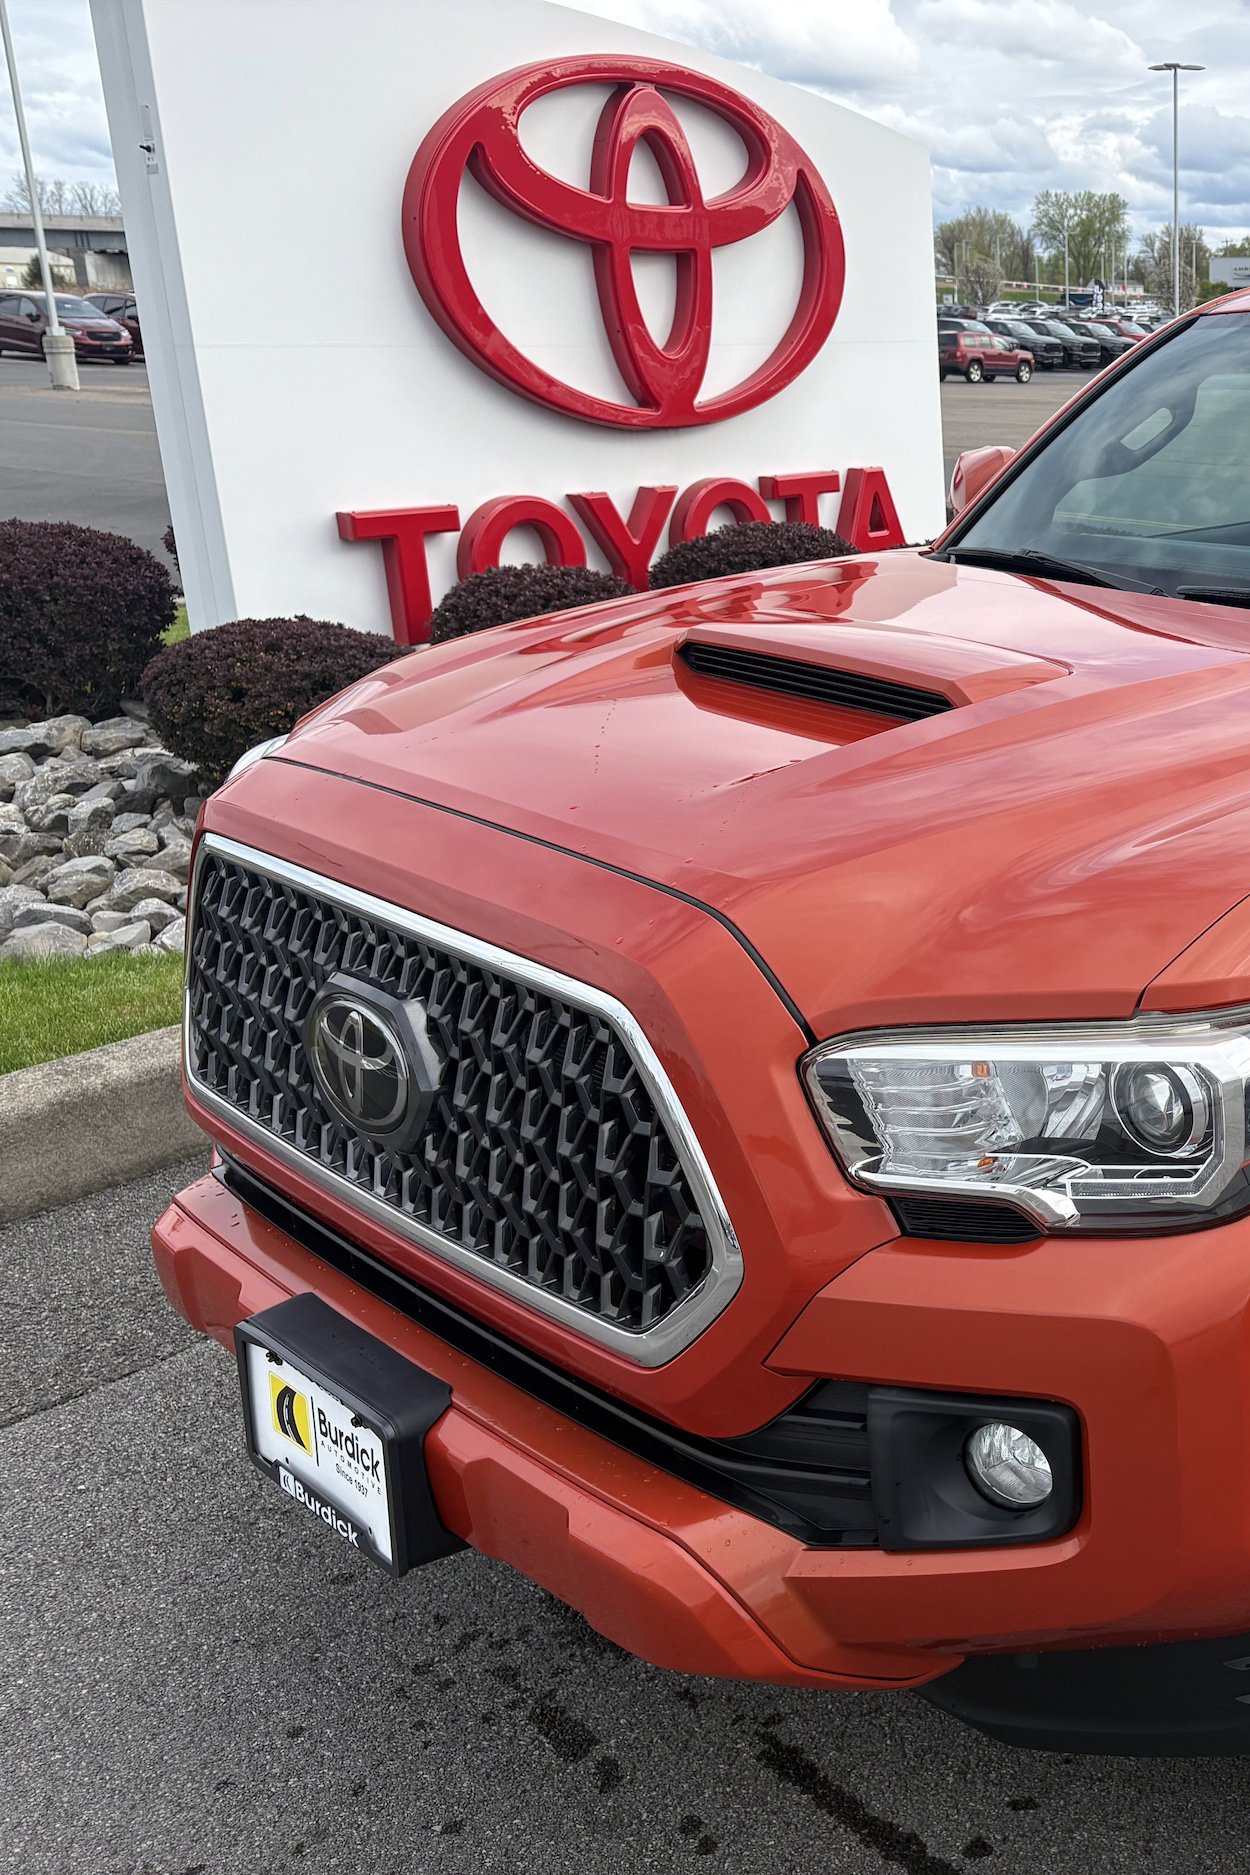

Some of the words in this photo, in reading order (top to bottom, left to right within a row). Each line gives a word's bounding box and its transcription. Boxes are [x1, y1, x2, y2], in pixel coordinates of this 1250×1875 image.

[336, 466, 907, 645] TOYOTA
[317, 1407, 381, 1483] Burdick
[320, 1440, 381, 1495] AUTOMOTIVE
[294, 1480, 360, 1548] Burdick
[335, 1463, 353, 1485] Since
[354, 1479, 369, 1498] 1937
